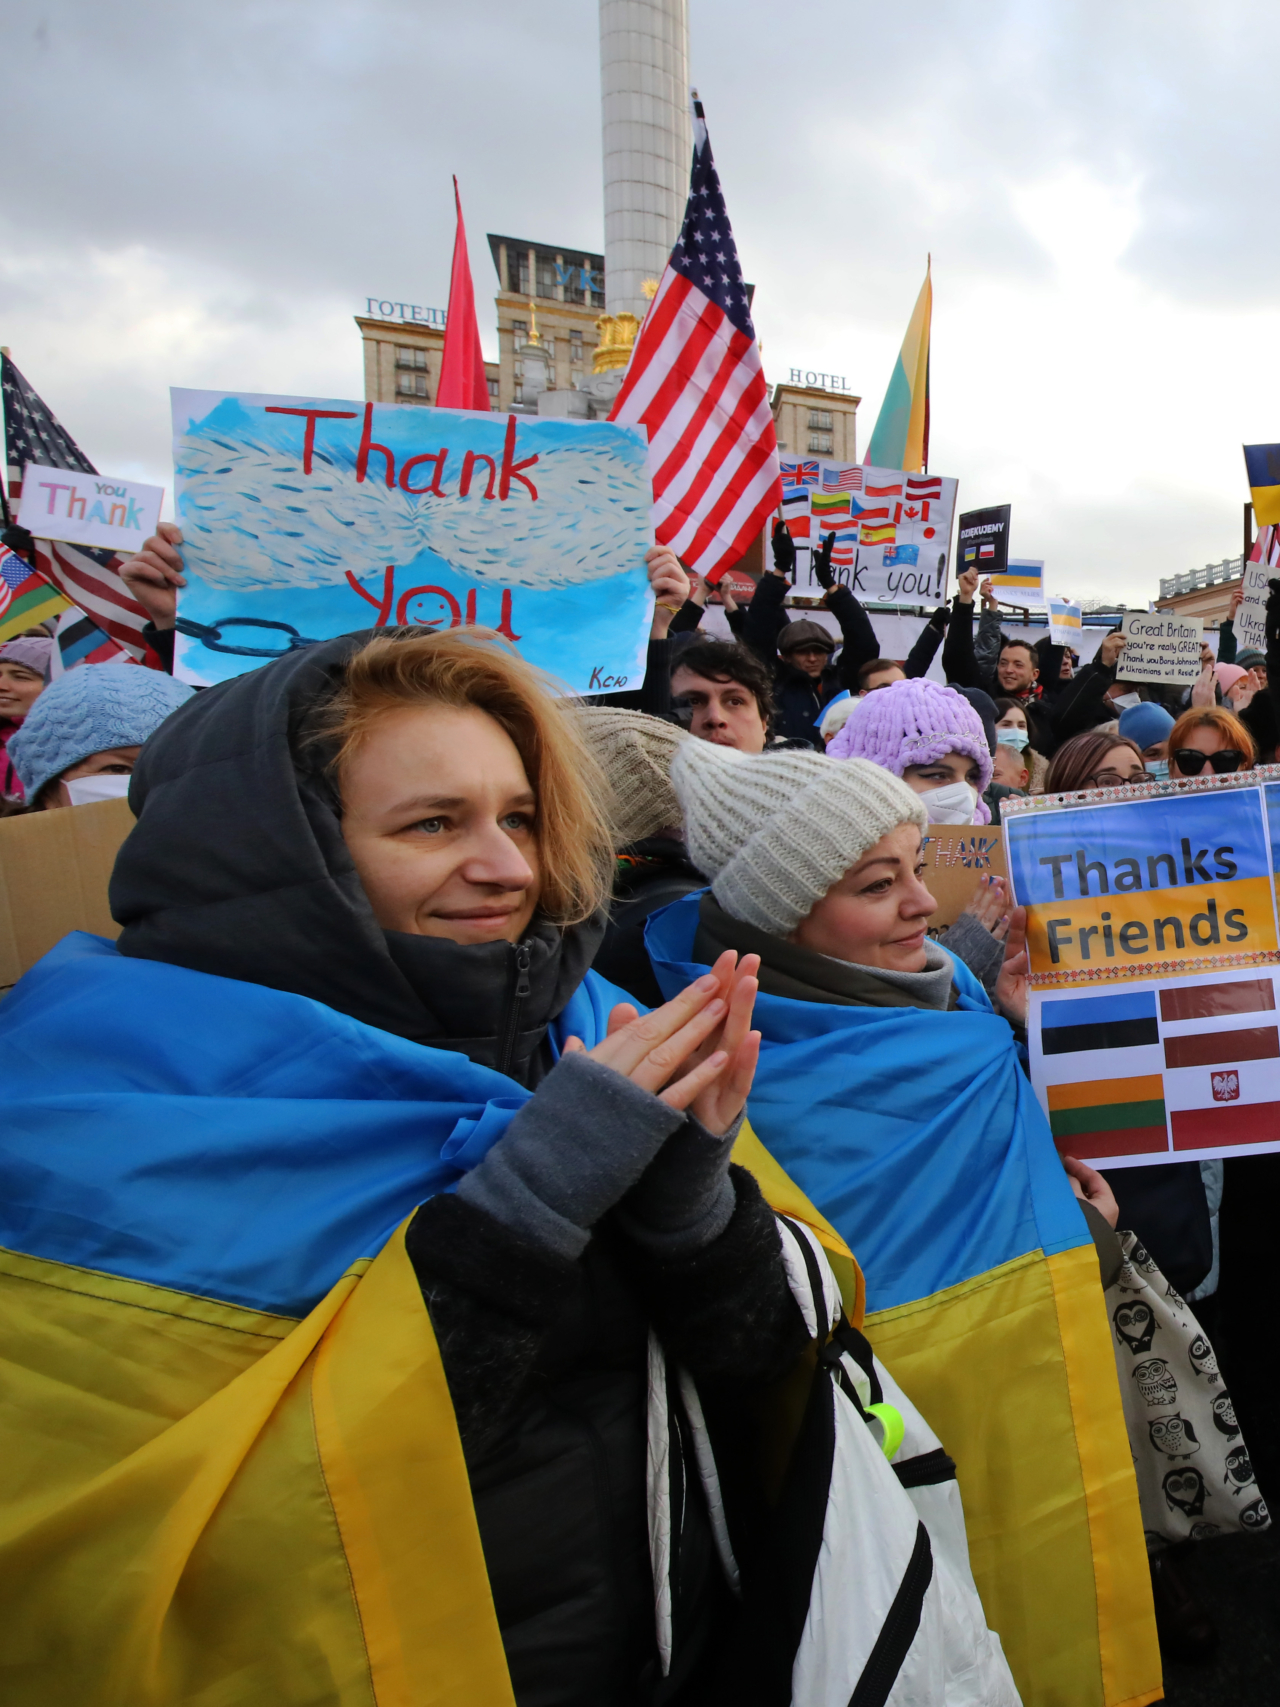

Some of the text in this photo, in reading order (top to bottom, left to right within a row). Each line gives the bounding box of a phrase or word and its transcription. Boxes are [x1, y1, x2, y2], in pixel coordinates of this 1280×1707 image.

[789, 367, 851, 391] HOTEL
[265, 402, 540, 501] Thank
[878, 553, 945, 602] you!
[1244, 595, 1260, 605] and
[1129, 619, 1197, 638] Great Britain
[1123, 652, 1144, 663] Thank
[1127, 641, 1201, 654] you're really GREAT!
[589, 666, 628, 689] Ксю
[1165, 668, 1175, 676] will
[1039, 838, 1238, 899] Thanks
[1047, 898, 1248, 964] Friends
